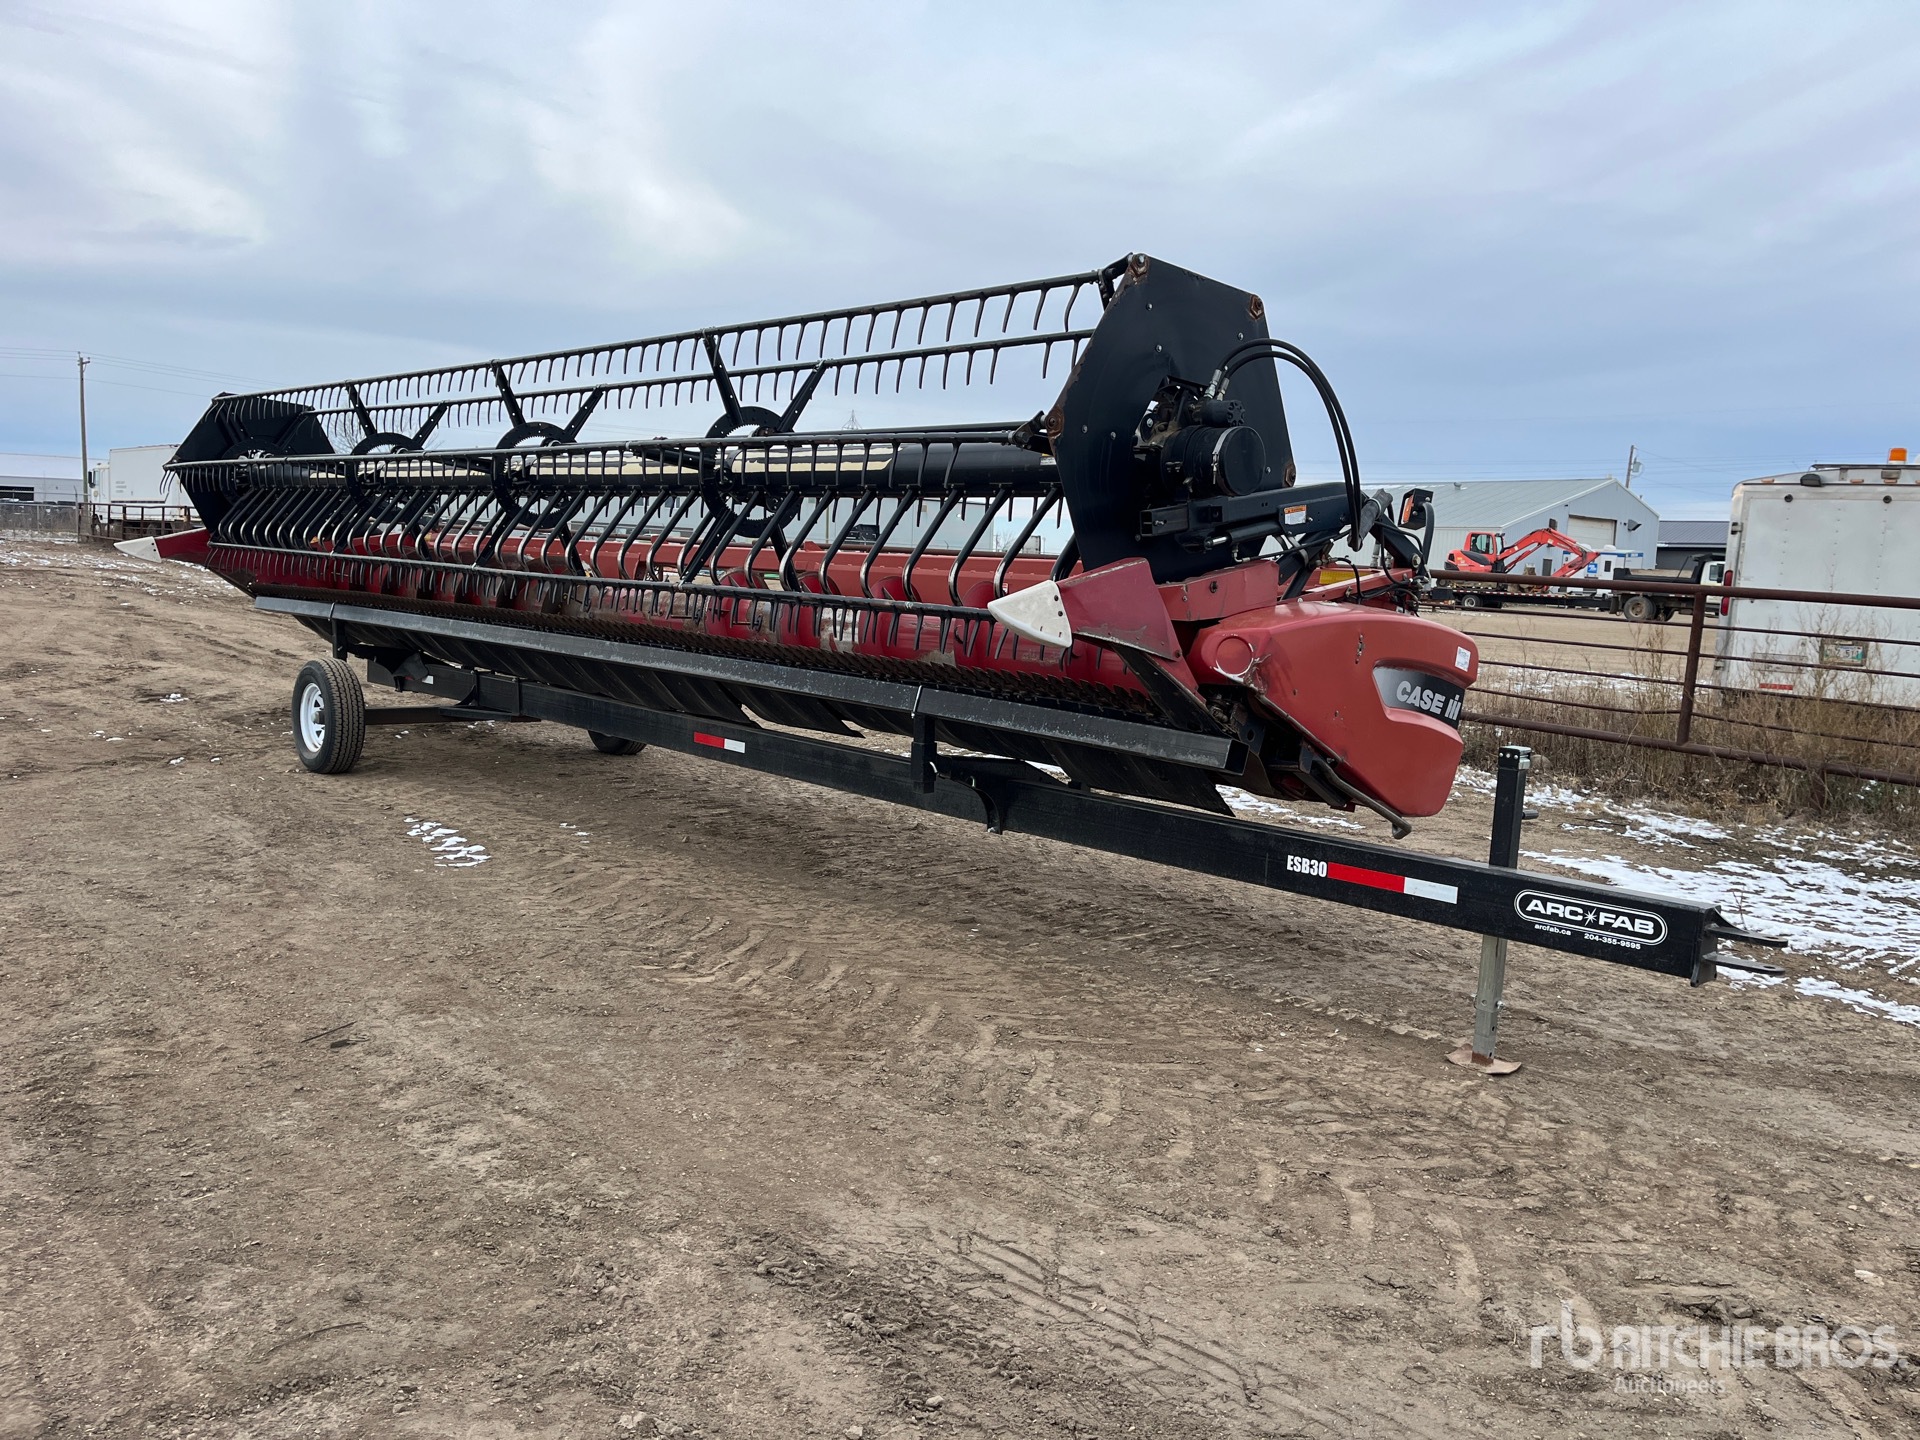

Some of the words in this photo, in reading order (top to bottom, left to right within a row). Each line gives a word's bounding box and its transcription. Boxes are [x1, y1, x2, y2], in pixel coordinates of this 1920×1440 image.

[1396, 681, 1446, 714] CASE
[1286, 855, 1328, 878] ESB30
[1525, 900, 1584, 921] ARC
[1598, 912, 1655, 935] FAB
[1534, 923, 1572, 936] arcfab.ca
